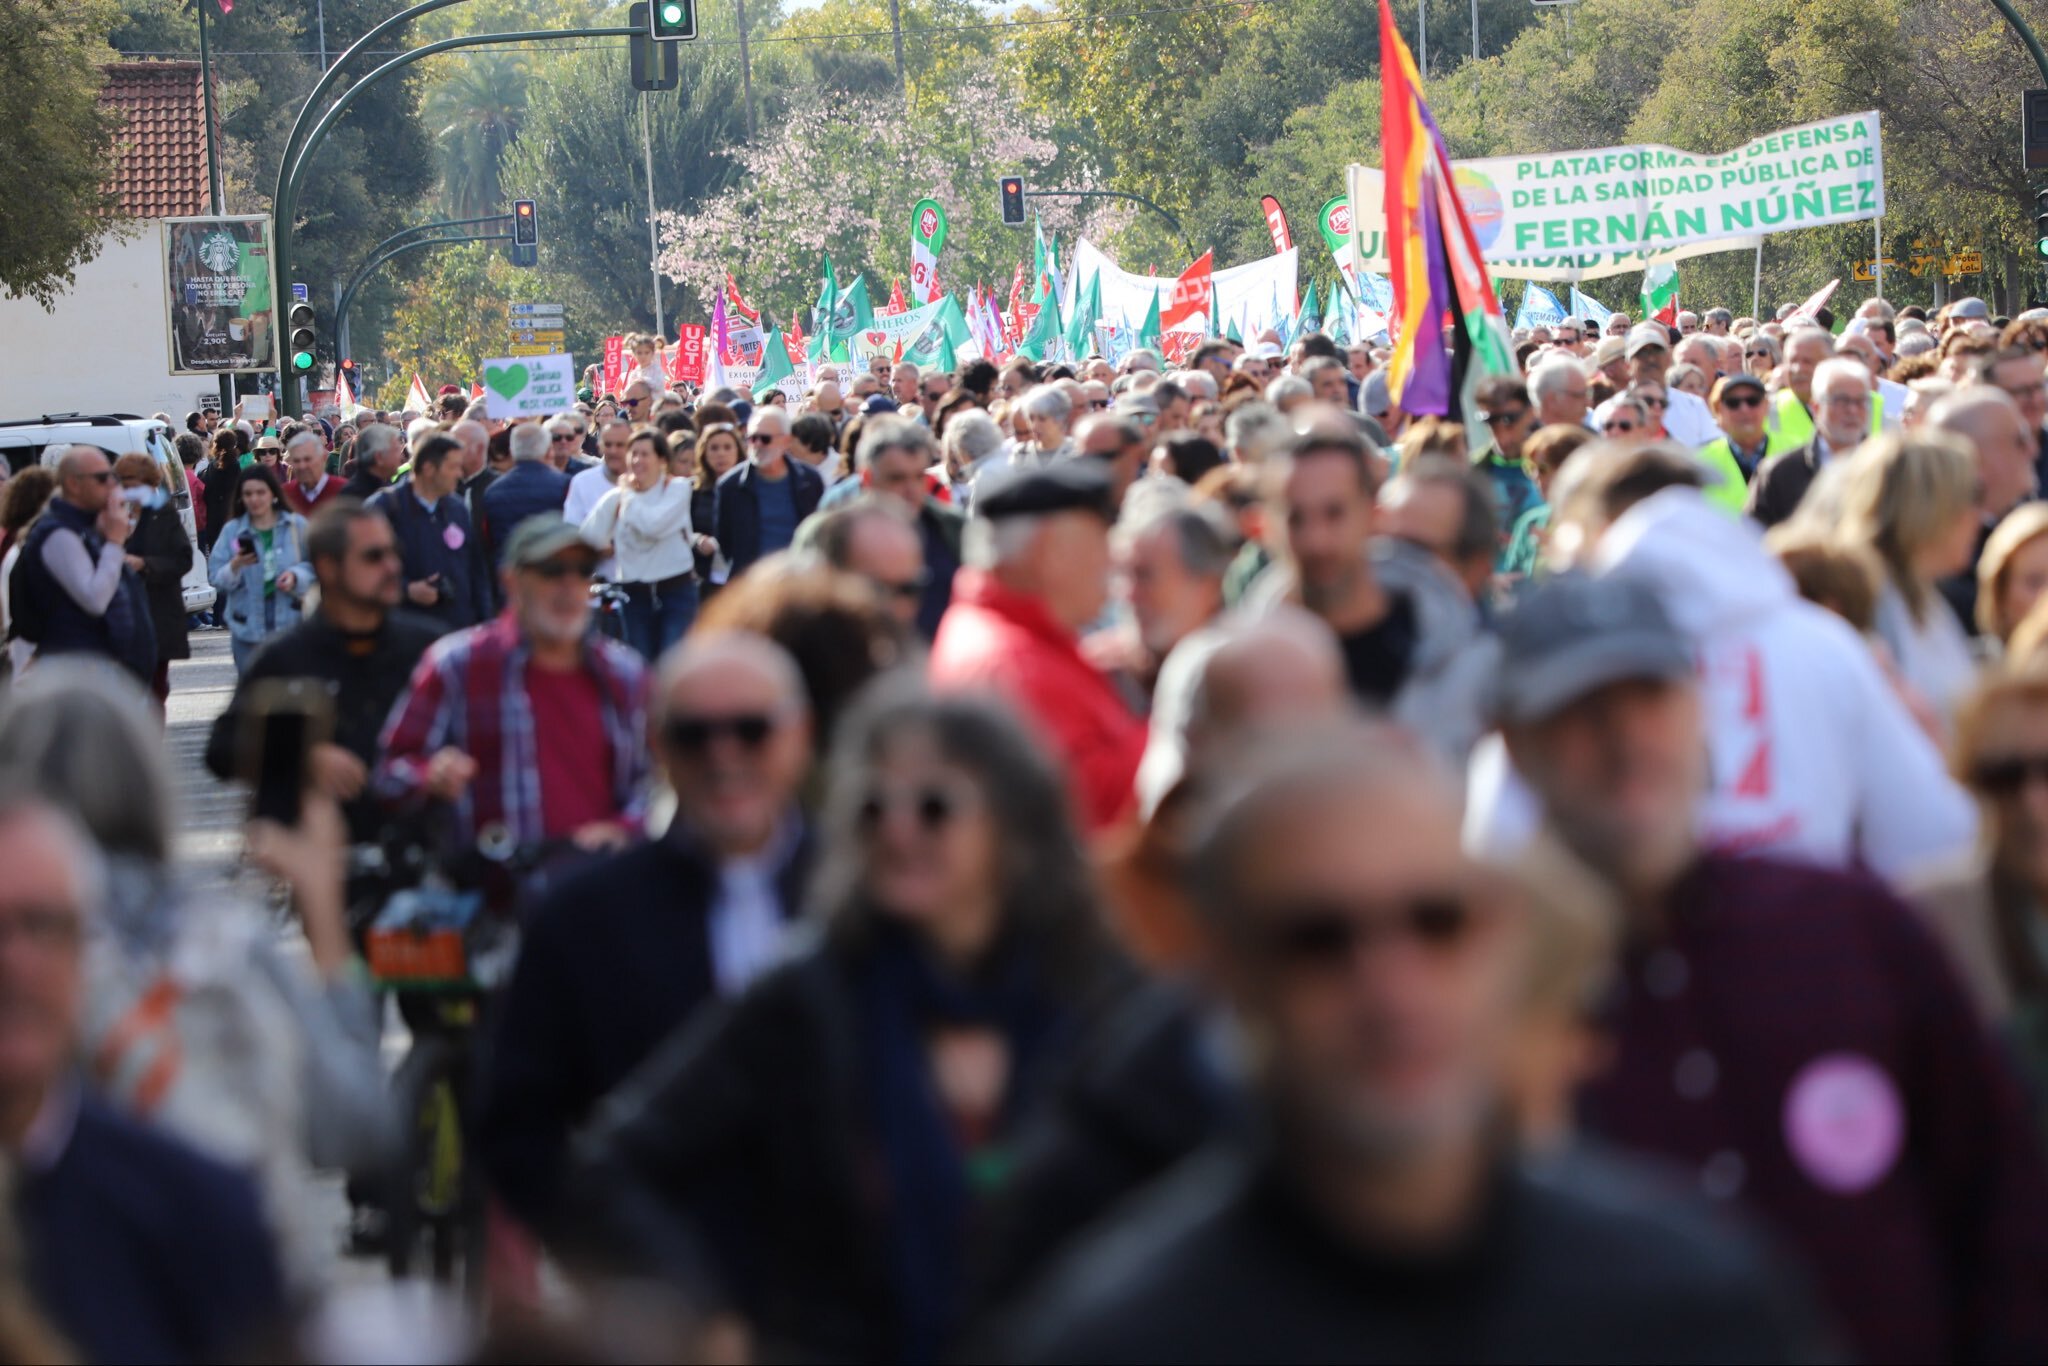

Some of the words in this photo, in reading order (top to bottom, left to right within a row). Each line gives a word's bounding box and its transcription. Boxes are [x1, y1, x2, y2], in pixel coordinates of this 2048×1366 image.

[1511, 188, 1548, 209] DE
[1554, 184, 1588, 206] LA
[1594, 173, 1714, 202] SANIDAD
[1720, 152, 1839, 190] PÚBLICA
[1844, 146, 1875, 169] DE
[1517, 150, 1697, 181] PLATAFORMA
[1705, 152, 1740, 168] EN
[1746, 119, 1869, 158] DEFENSA
[1514, 201, 1708, 252] FERNÁN
[1719, 179, 1877, 231] NÚÑEZ
[607, 340, 619, 377] UGT
[685, 326, 701, 365] UGT
